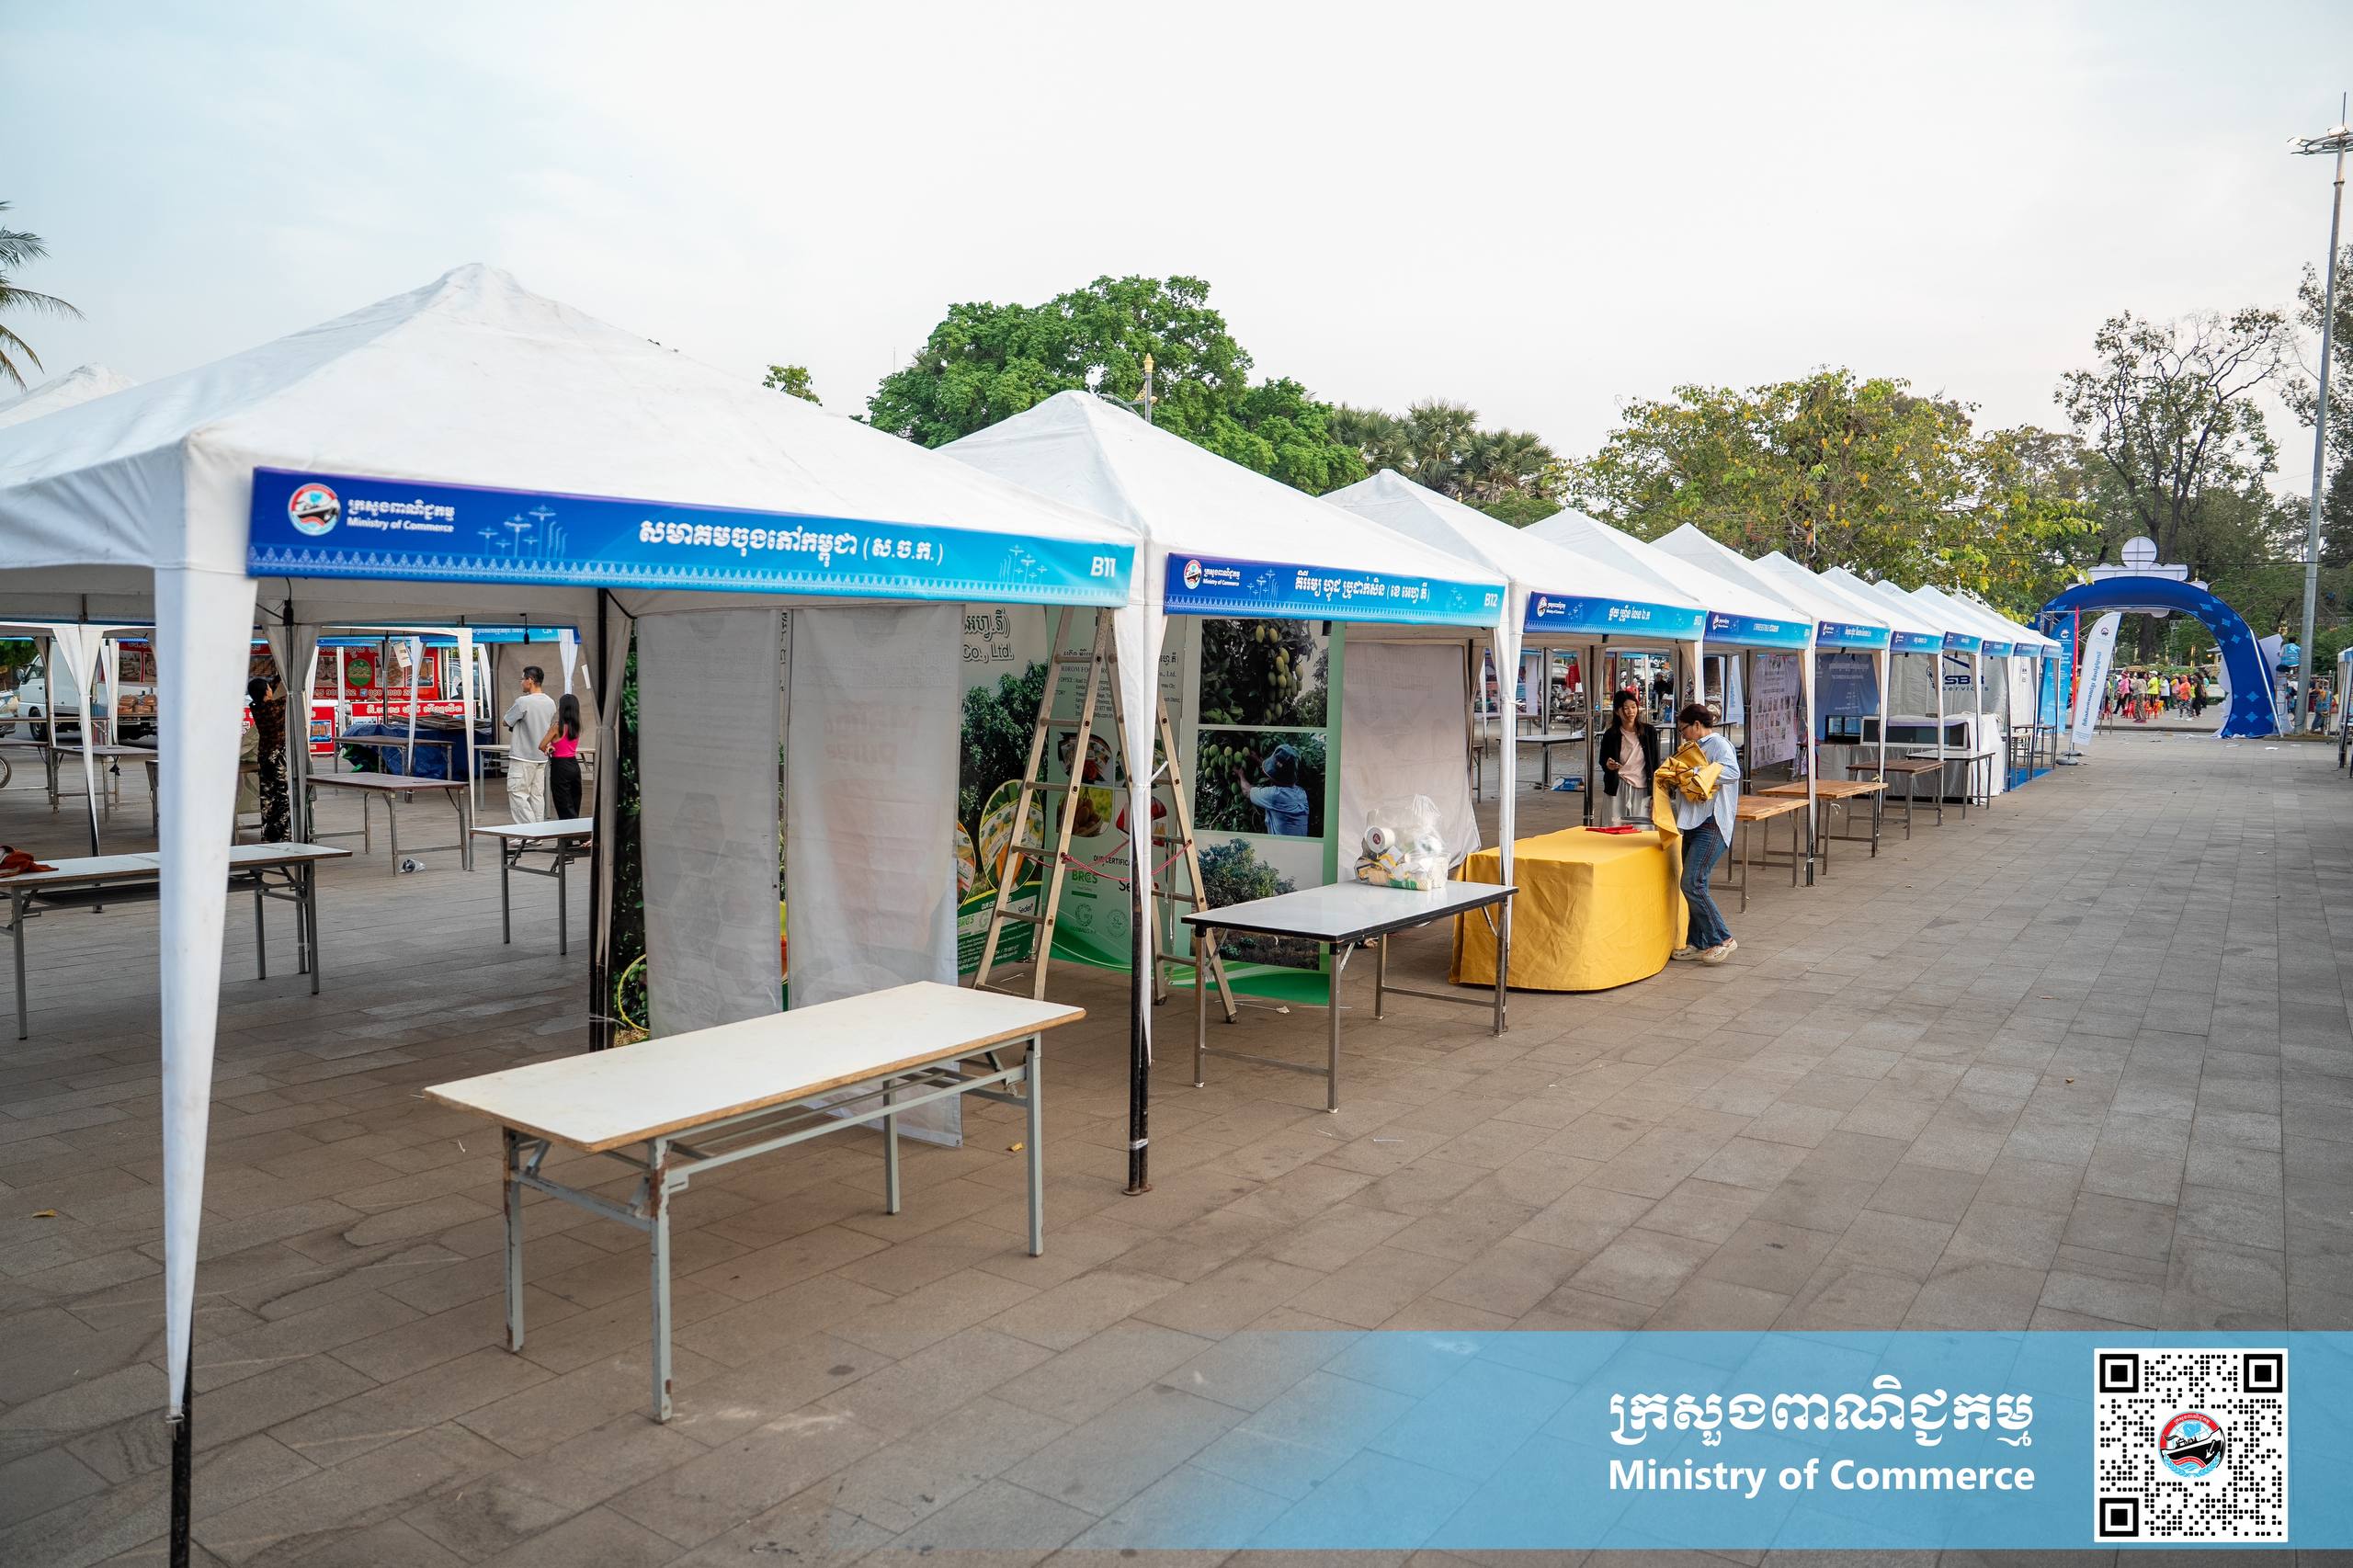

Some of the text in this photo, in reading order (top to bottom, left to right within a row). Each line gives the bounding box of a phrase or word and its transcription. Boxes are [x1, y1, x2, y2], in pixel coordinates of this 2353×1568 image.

[347, 516, 455, 533] Ministry of Commerce
[1090, 556, 1117, 578] B11
[1484, 593, 1498, 607] B12
[991, 642, 1015, 661] Ltd.
